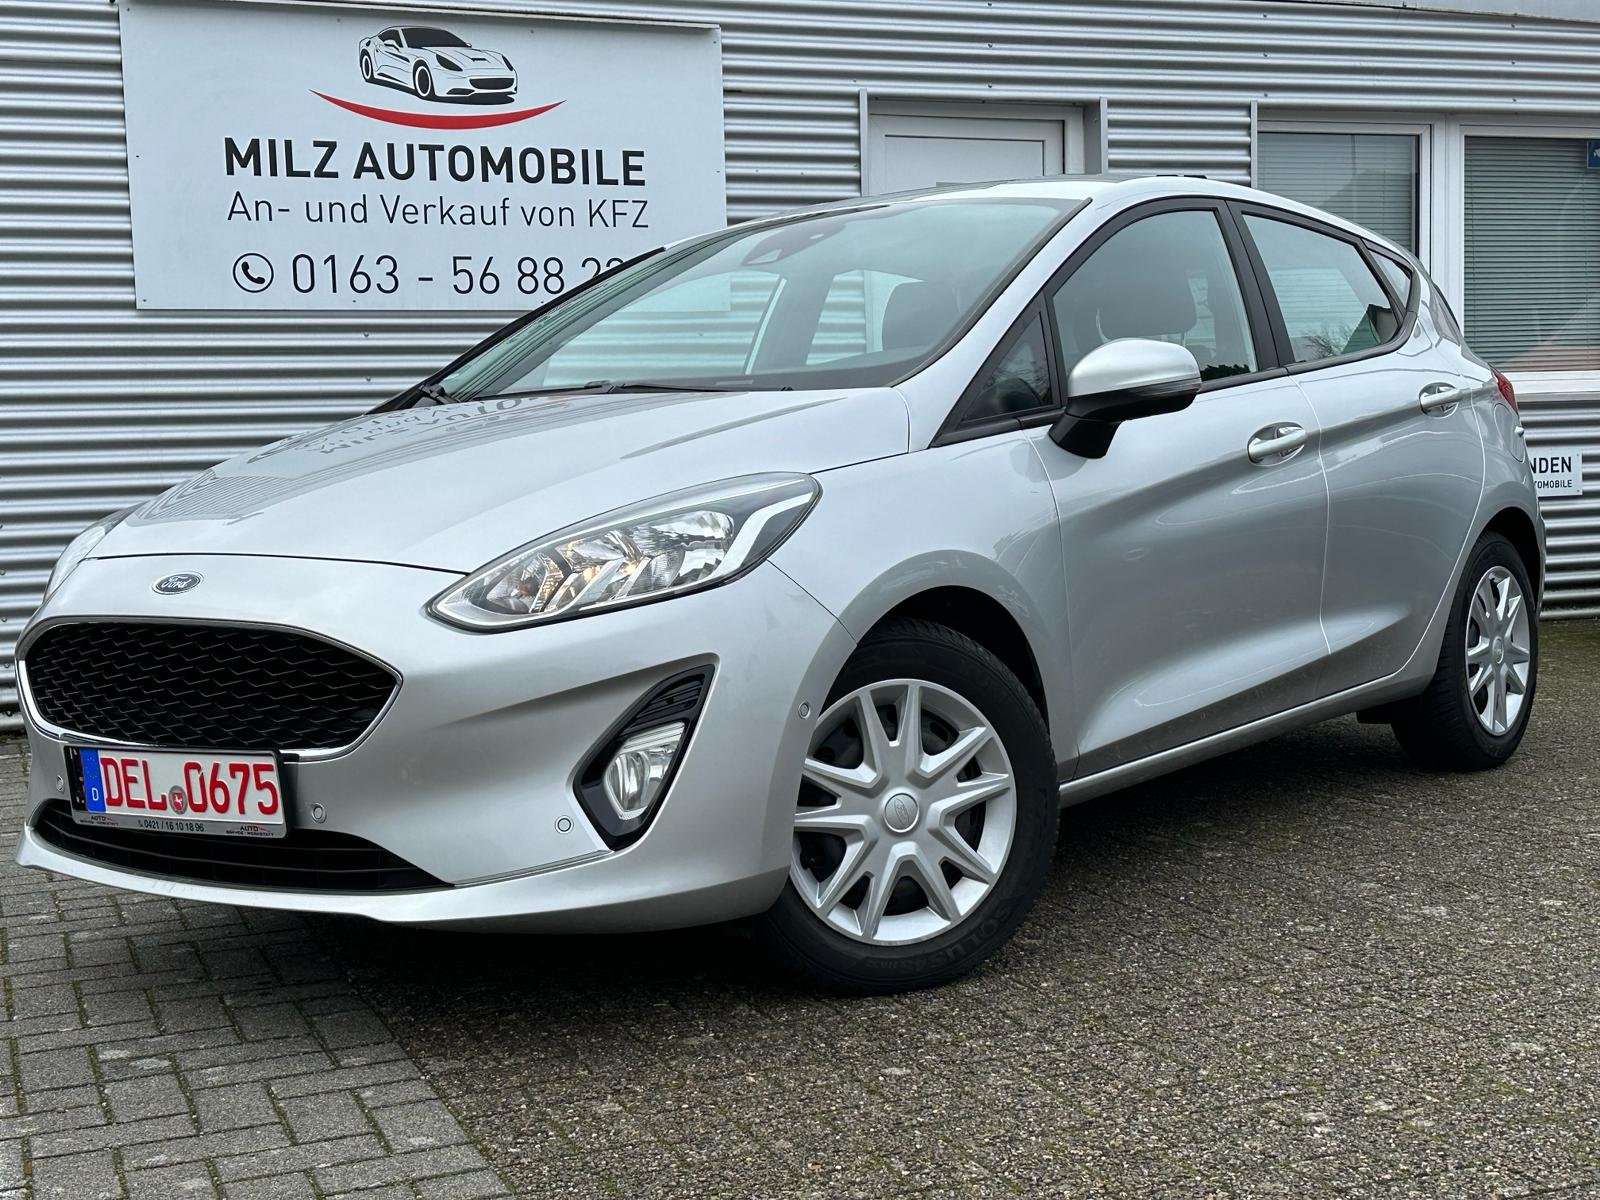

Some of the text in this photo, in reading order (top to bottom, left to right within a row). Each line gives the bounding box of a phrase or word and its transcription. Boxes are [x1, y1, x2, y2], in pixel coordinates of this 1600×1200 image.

[224, 137, 646, 186] MILZ AUTOMOBILE
[227, 190, 649, 230] An- und Verkauf von KFZ
[292, 253, 399, 294] 0163
[452, 255, 500, 295] 56
[517, 256, 565, 295] 88
[92, 787, 99, 801] D
[100, 757, 279, 815] DEL 0675
